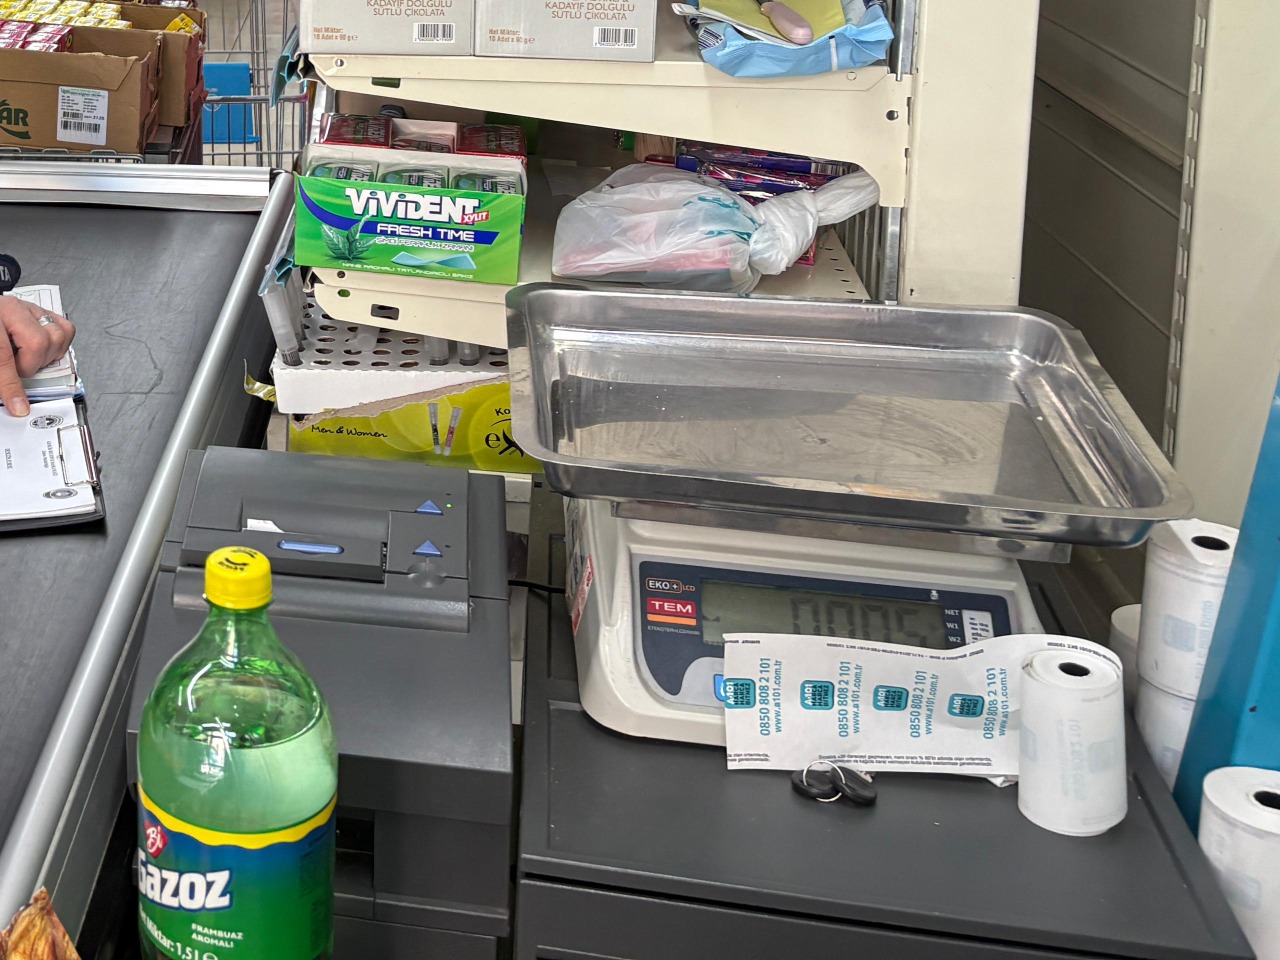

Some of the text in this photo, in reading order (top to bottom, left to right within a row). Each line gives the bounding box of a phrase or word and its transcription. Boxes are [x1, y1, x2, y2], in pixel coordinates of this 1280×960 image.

[366, 0, 453, 9] KADAYIF DOLGULU
[545, 2, 635, 12] KADAYIF DOLGULU
[499, 28, 520, 36] Miktar:
[462, 211, 488, 223] XYLIT
[377, 223, 474, 242] FRESH TIME
[311, 424, 388, 439] Men & Women
[649, 580, 670, 590] EKO
[651, 600, 692, 614] TEM
[760, 658, 770, 674] 101
[840, 661, 850, 677] 101
[915, 670, 927, 685] 101
[986, 667, 996, 687] 101
[759, 685, 770, 707] 808
[772, 660, 783, 733] www.a101.com.tr
[837, 687, 849, 708] 808
[851, 664, 862, 733] www.a101.com.tr
[911, 693, 923, 710] 808
[925, 674, 939, 735] www.a101.com.tr
[999, 668, 1008, 737] www.a101.com.tr
[987, 699, 998, 717] 808
[759, 707, 770, 736] 0850
[838, 709, 849, 737] 0850
[910, 710, 921, 738] 0850
[983, 717, 995, 740] 0850
[191, 923, 244, 940] FRAMBUAZ
[191, 933, 234, 948] AROMALI
